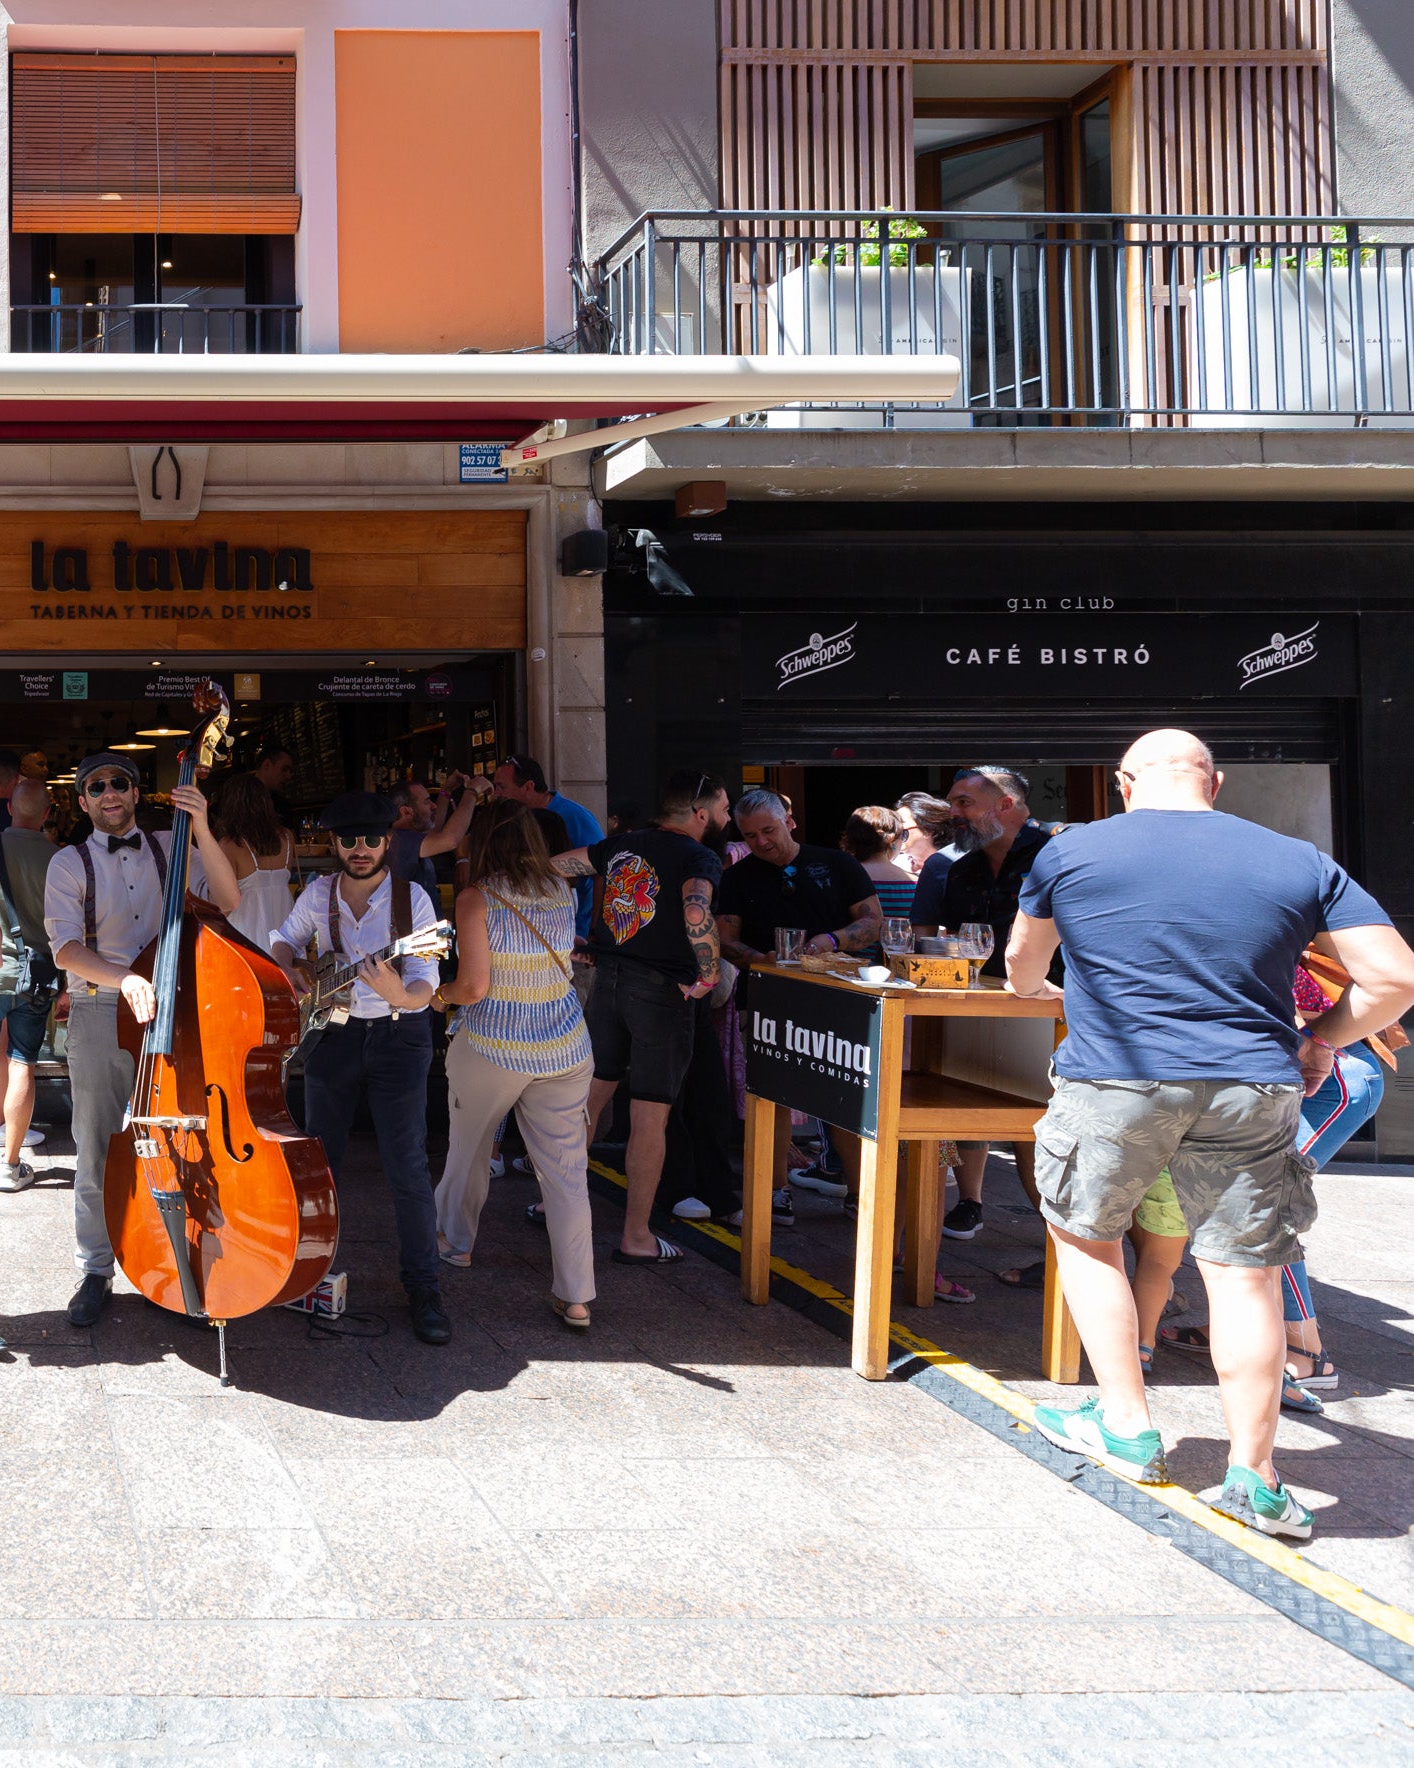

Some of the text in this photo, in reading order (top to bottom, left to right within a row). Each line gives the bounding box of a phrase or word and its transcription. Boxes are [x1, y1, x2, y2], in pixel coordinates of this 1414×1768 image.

[461, 456, 475, 465] 902
[477, 456, 486, 465] 57
[487, 456, 497, 465] 07
[30, 541, 315, 592] la tavina
[30, 605, 313, 620] TABERNA Y TIENDA DE VINOS
[1006, 596, 1115, 613] gin club
[780, 636, 852, 679] Schweppes
[946, 644, 1150, 665] CAFÉ BISTRÓ
[1242, 636, 1314, 679] Schweppes
[24, 682, 49, 690] Choice
[158, 675, 184, 683] Premio
[201, 675, 211, 683] Of
[318, 683, 350, 691] Crujiente
[753, 1010, 872, 1075] la tavina
[752, 1044, 870, 1088] VINOS Y COMIDAS
